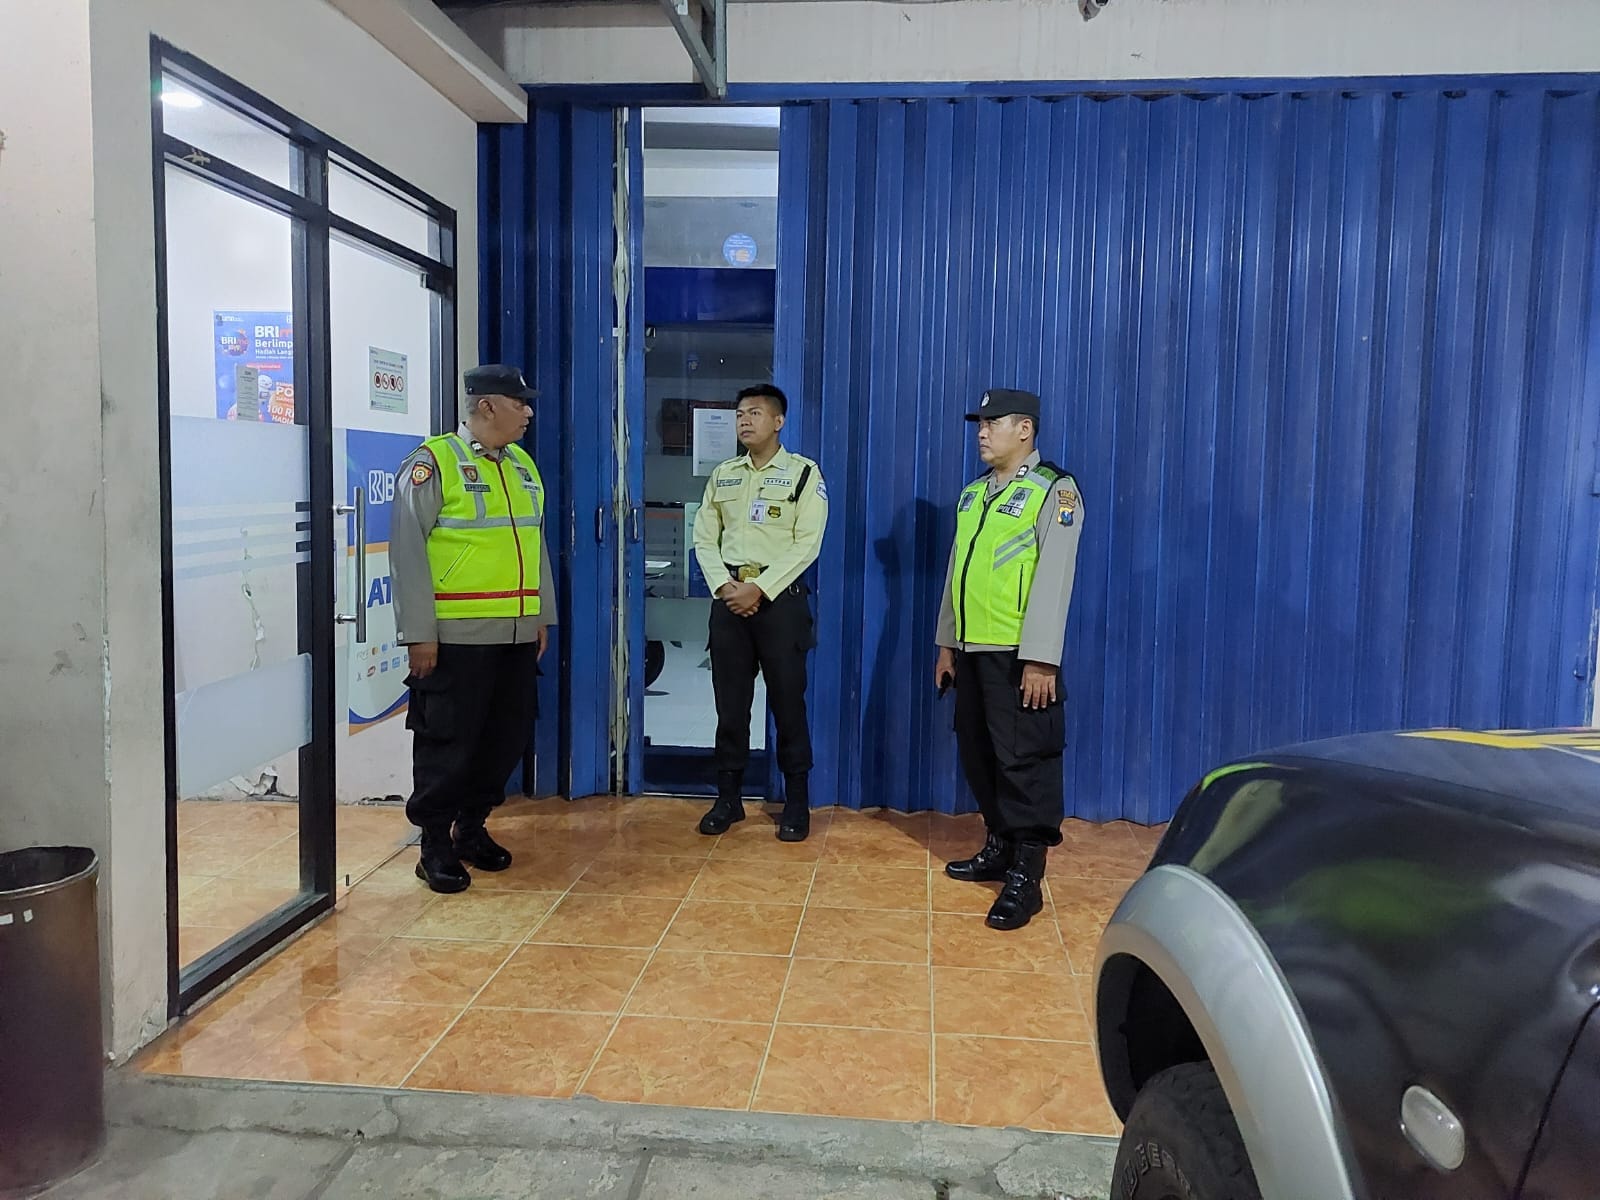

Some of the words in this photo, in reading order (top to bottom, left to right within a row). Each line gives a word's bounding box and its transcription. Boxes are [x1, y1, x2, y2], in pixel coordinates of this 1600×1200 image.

[255, 339, 293, 350] Berlimp
[276, 386, 294, 398] PO
[367, 576, 392, 607] AT
